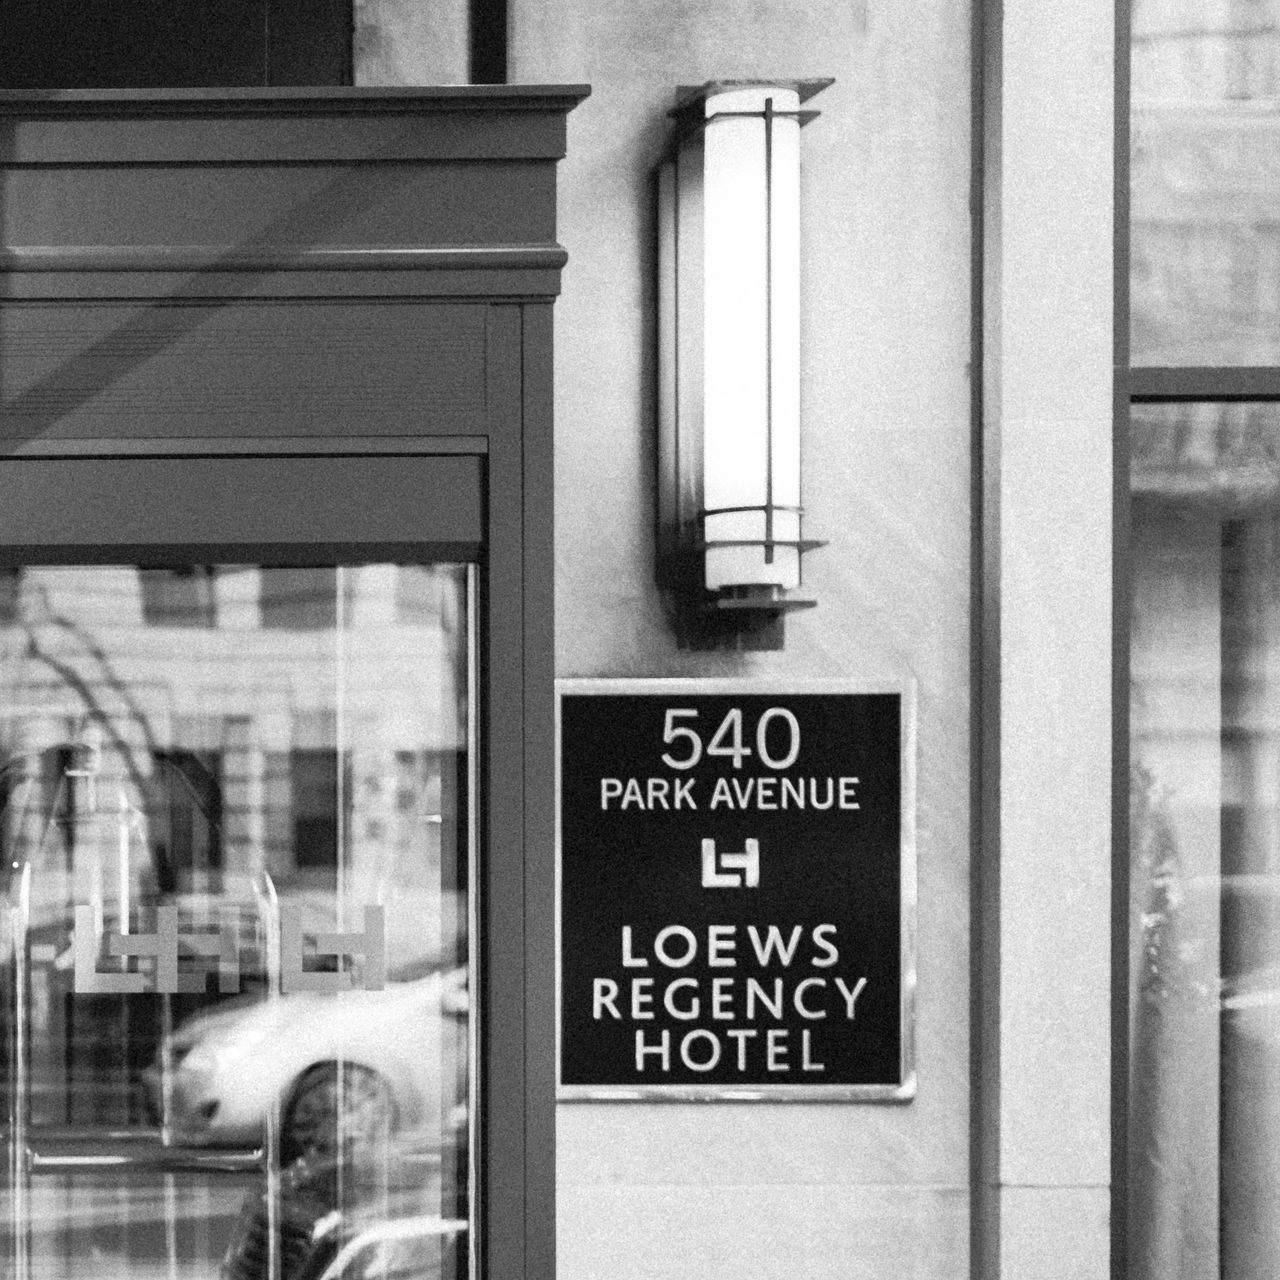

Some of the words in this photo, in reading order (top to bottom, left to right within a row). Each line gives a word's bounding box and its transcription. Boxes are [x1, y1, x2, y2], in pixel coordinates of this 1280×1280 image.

[662, 708, 800, 769] 540
[600, 778, 698, 810] PARK
[710, 777, 860, 809] AVENUE
[622, 924, 838, 968] LOEWS
[593, 978, 867, 1020] REGENCY
[635, 1029, 824, 1071] HOTEL
